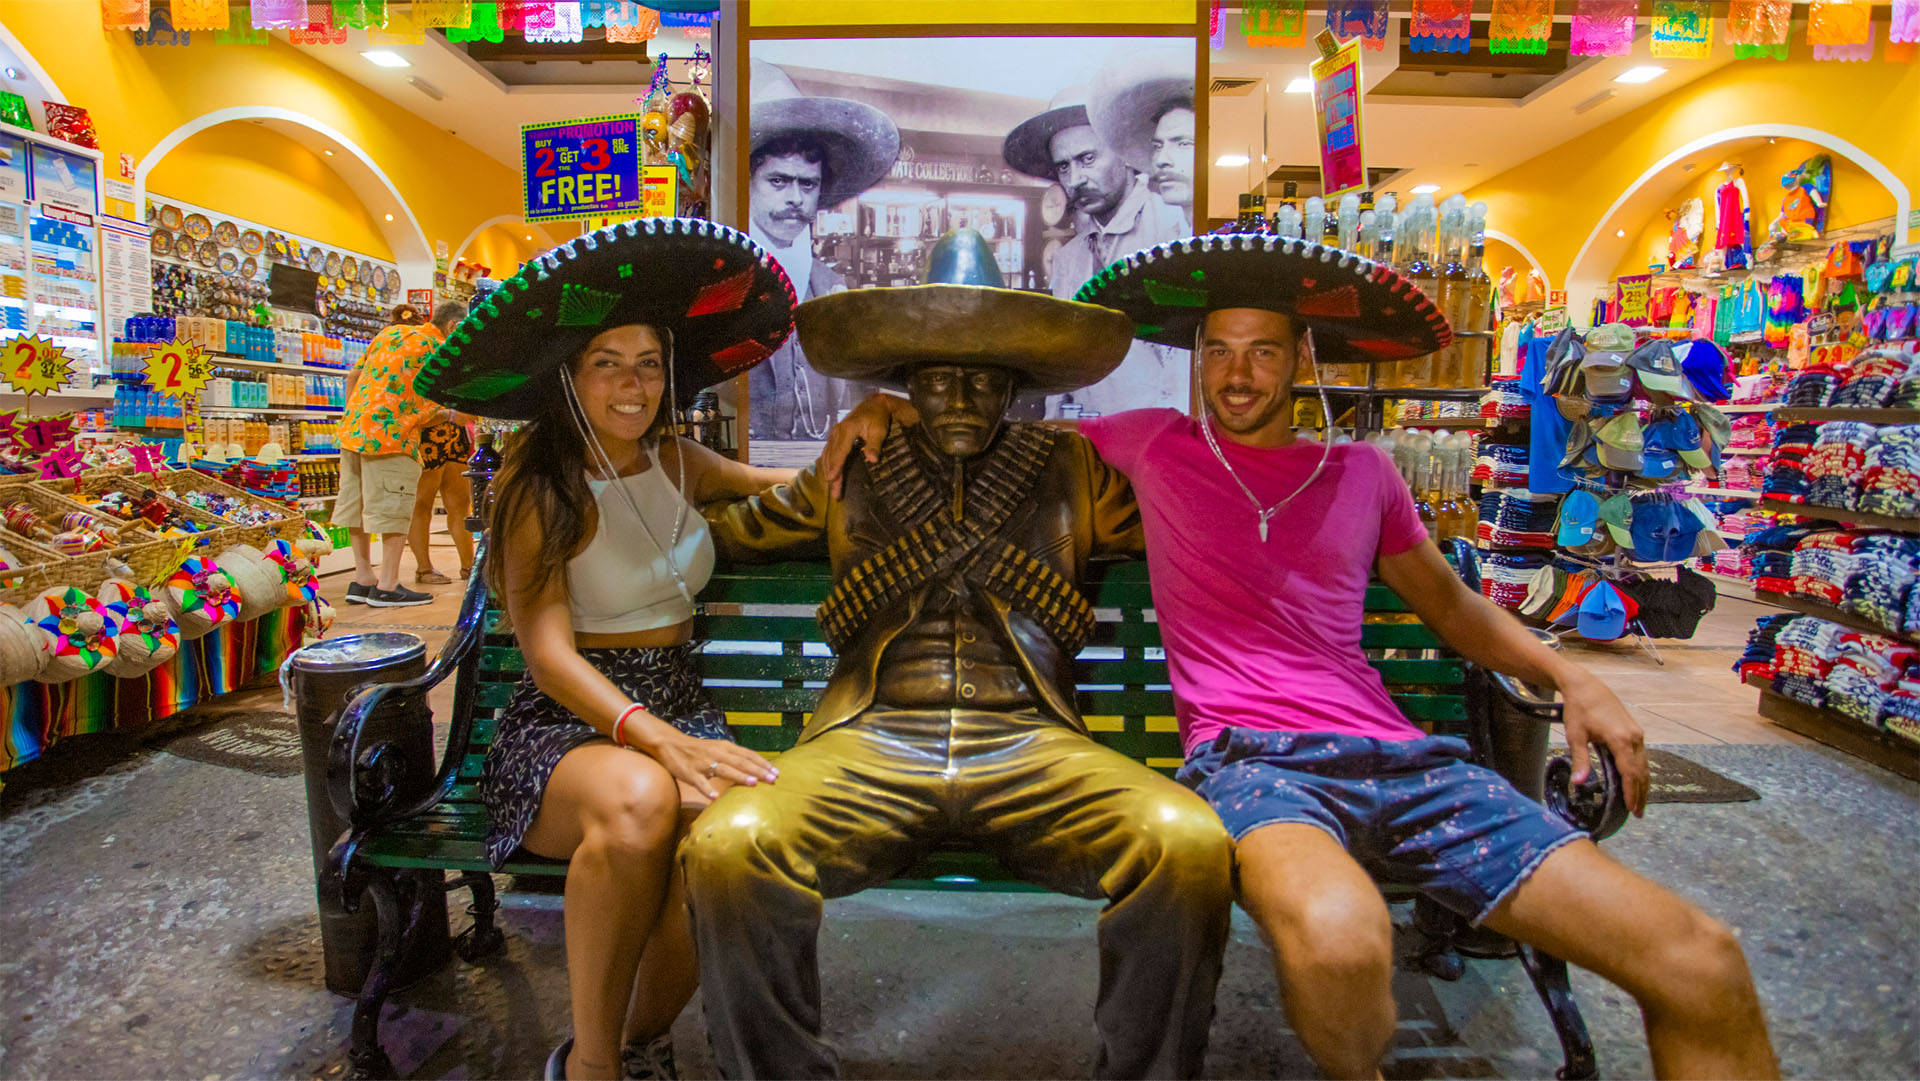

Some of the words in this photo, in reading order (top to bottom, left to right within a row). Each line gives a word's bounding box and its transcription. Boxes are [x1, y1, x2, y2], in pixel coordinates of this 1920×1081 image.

[558, 120, 634, 139] PROMOTION
[1327, 123, 1354, 154] FREE
[535, 139, 552, 148] BUY
[612, 138, 625, 146] RD
[612, 144, 630, 154] ONE
[535, 147, 556, 177] 2
[560, 151, 579, 164] GET
[580, 138, 611, 171] 3
[915, 161, 974, 182] COLLECTION
[541, 173, 621, 205] FREE!
